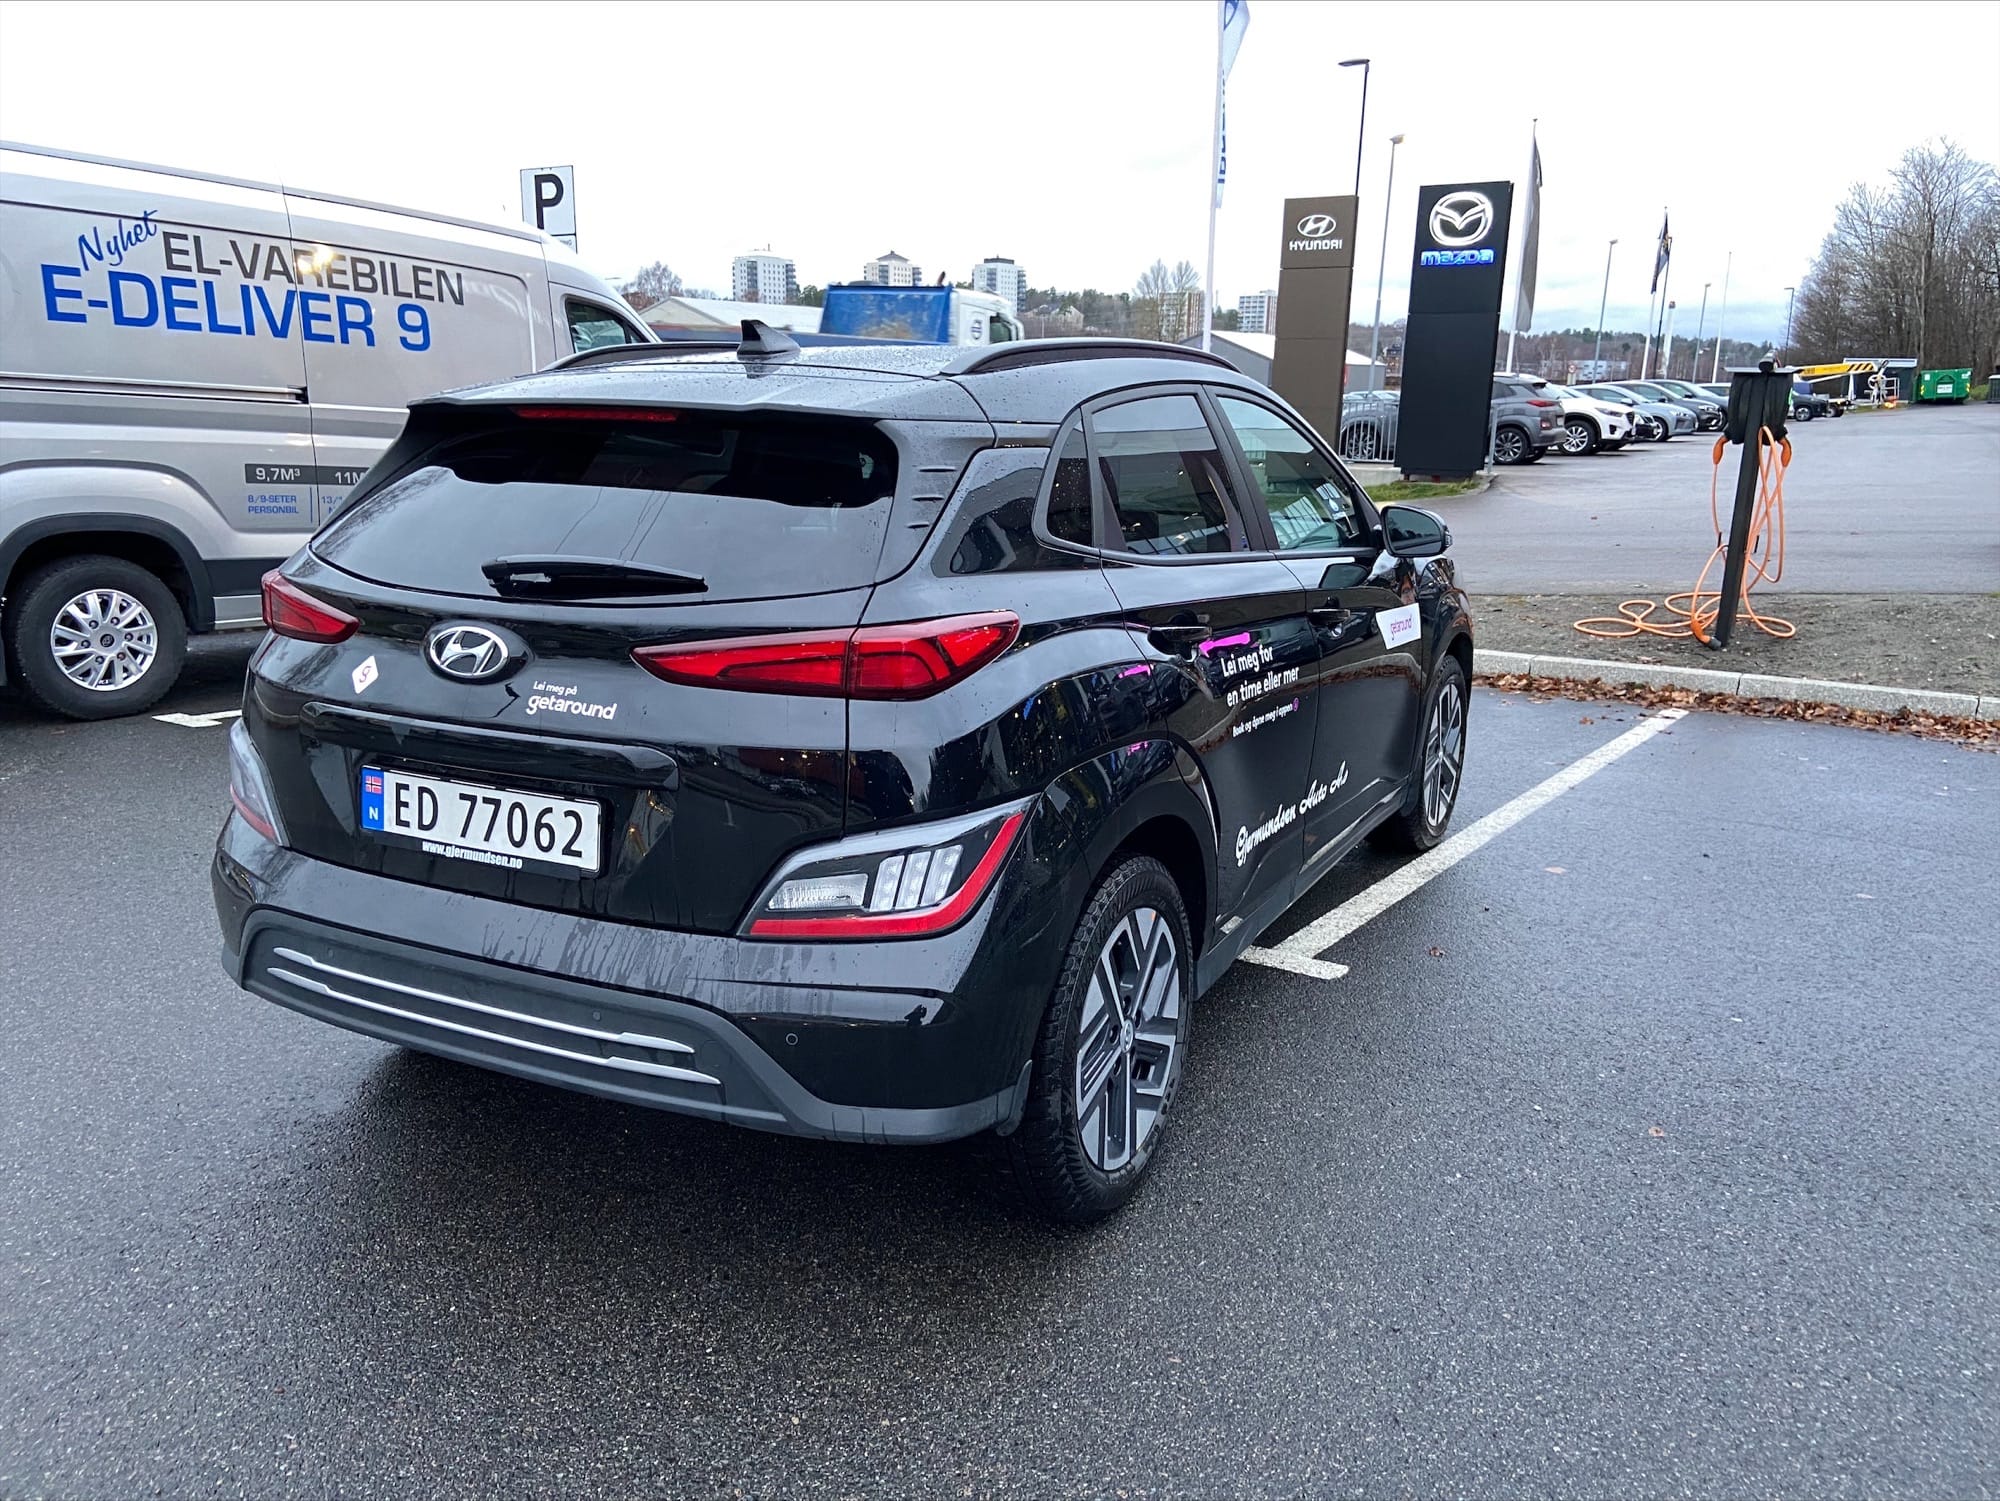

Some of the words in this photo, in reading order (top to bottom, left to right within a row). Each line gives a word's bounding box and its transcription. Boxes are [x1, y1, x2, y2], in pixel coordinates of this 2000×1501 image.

[534, 173, 564, 230] P
[78, 209, 158, 271] Nyhet
[1289, 239, 1343, 251] HYUNDAI
[162, 231, 465, 306] EL-VAREBILEN
[1420, 249, 1495, 266] mazda
[41, 263, 376, 348] E-DELIVER
[397, 303, 432, 352] 9
[247, 504, 299, 515] PERSONBIL
[1221, 653, 1237, 678] Lei
[1237, 651, 1260, 673] meg
[1259, 644, 1274, 664] for
[533, 680, 547, 691] Lei
[546, 683, 565, 696] meg
[565, 685, 578, 697] på
[1227, 690, 1239, 707] en
[1240, 680, 1262, 701] time
[1263, 670, 1282, 693] eller
[1283, 666, 1300, 685] mer
[525, 694, 618, 721] getaround
[368, 806, 379, 820] N
[395, 781, 440, 832] ED
[458, 792, 584, 859] 77062
[1235, 803, 1297, 868] Gjermundsen
[1299, 778, 1328, 815] Auto
[422, 840, 523, 869] www.gjermundsen.no
